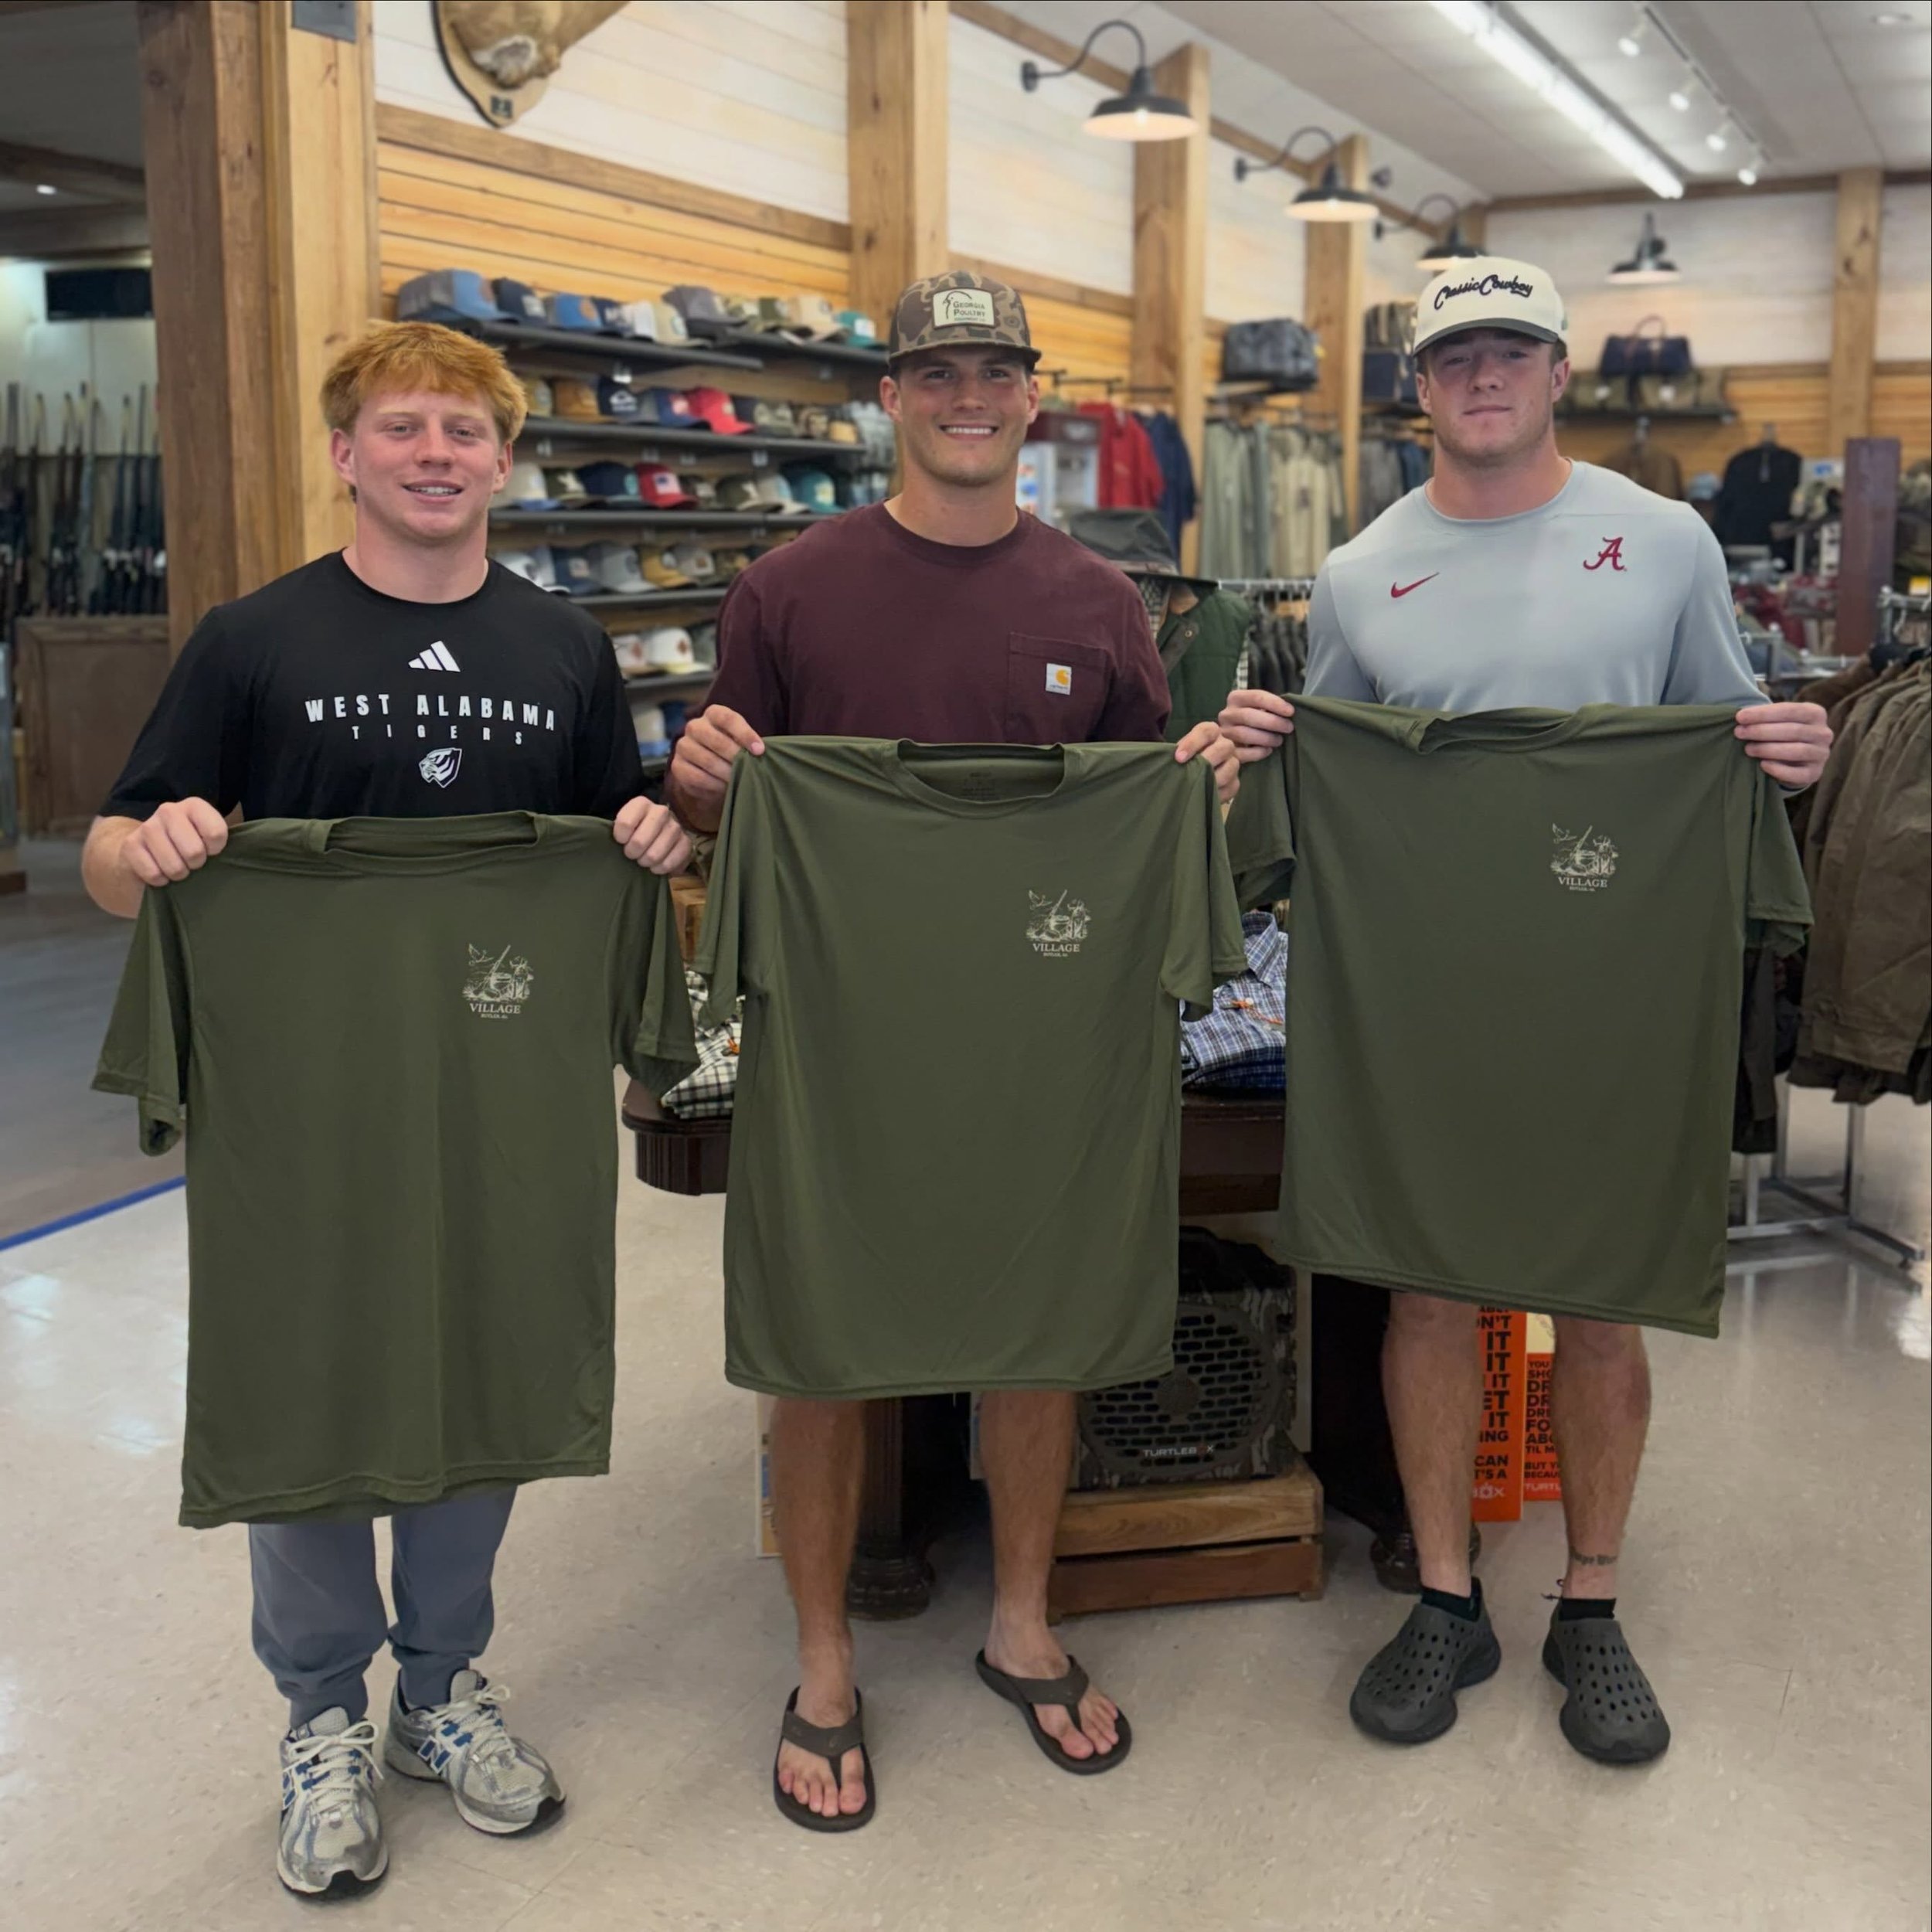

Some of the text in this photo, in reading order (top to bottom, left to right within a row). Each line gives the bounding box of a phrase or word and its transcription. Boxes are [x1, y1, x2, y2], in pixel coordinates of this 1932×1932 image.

[1434, 274, 1533, 311] Classic Cowboy
[953, 301, 985, 310] GEORGIA
[1583, 536, 1625, 571] A
[304, 693, 555, 731] WEST ALABAMA
[352, 724, 522, 745] TIGERS
[1558, 876, 1608, 888] VILLAGE
[1032, 943, 1080, 953] VILLAGE
[469, 1003, 522, 1014] VILLAGE
[1487, 1331, 1512, 1351] IT
[1486, 1352, 1511, 1371] IT
[1488, 1411, 1510, 1428] IT
[1473, 1455, 1509, 1468] CAN
